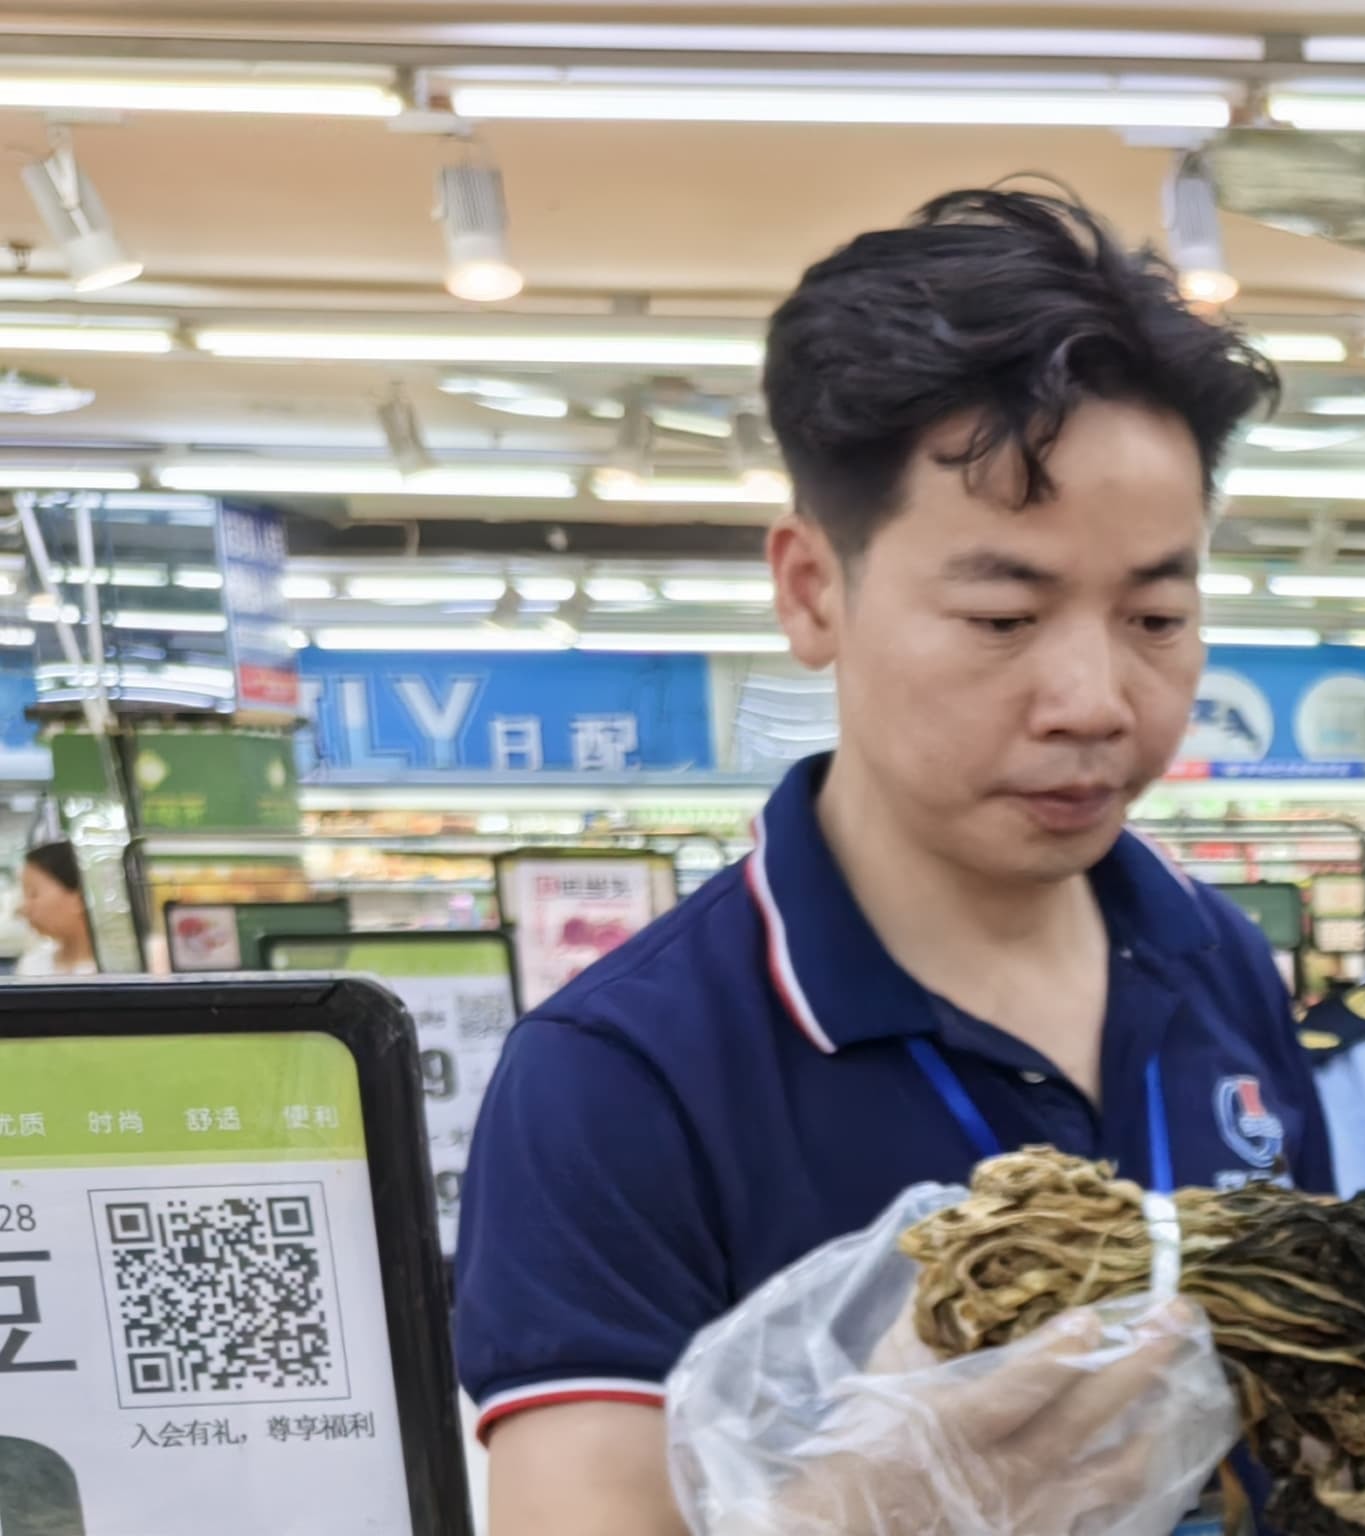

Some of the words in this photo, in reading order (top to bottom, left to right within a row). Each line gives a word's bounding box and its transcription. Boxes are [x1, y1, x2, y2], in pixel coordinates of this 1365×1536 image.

[489, 712, 640, 771] 日配
[88, 1110, 144, 1134] 时尚
[184, 1106, 241, 1132] 舒适
[282, 1104, 339, 1129] 便利
